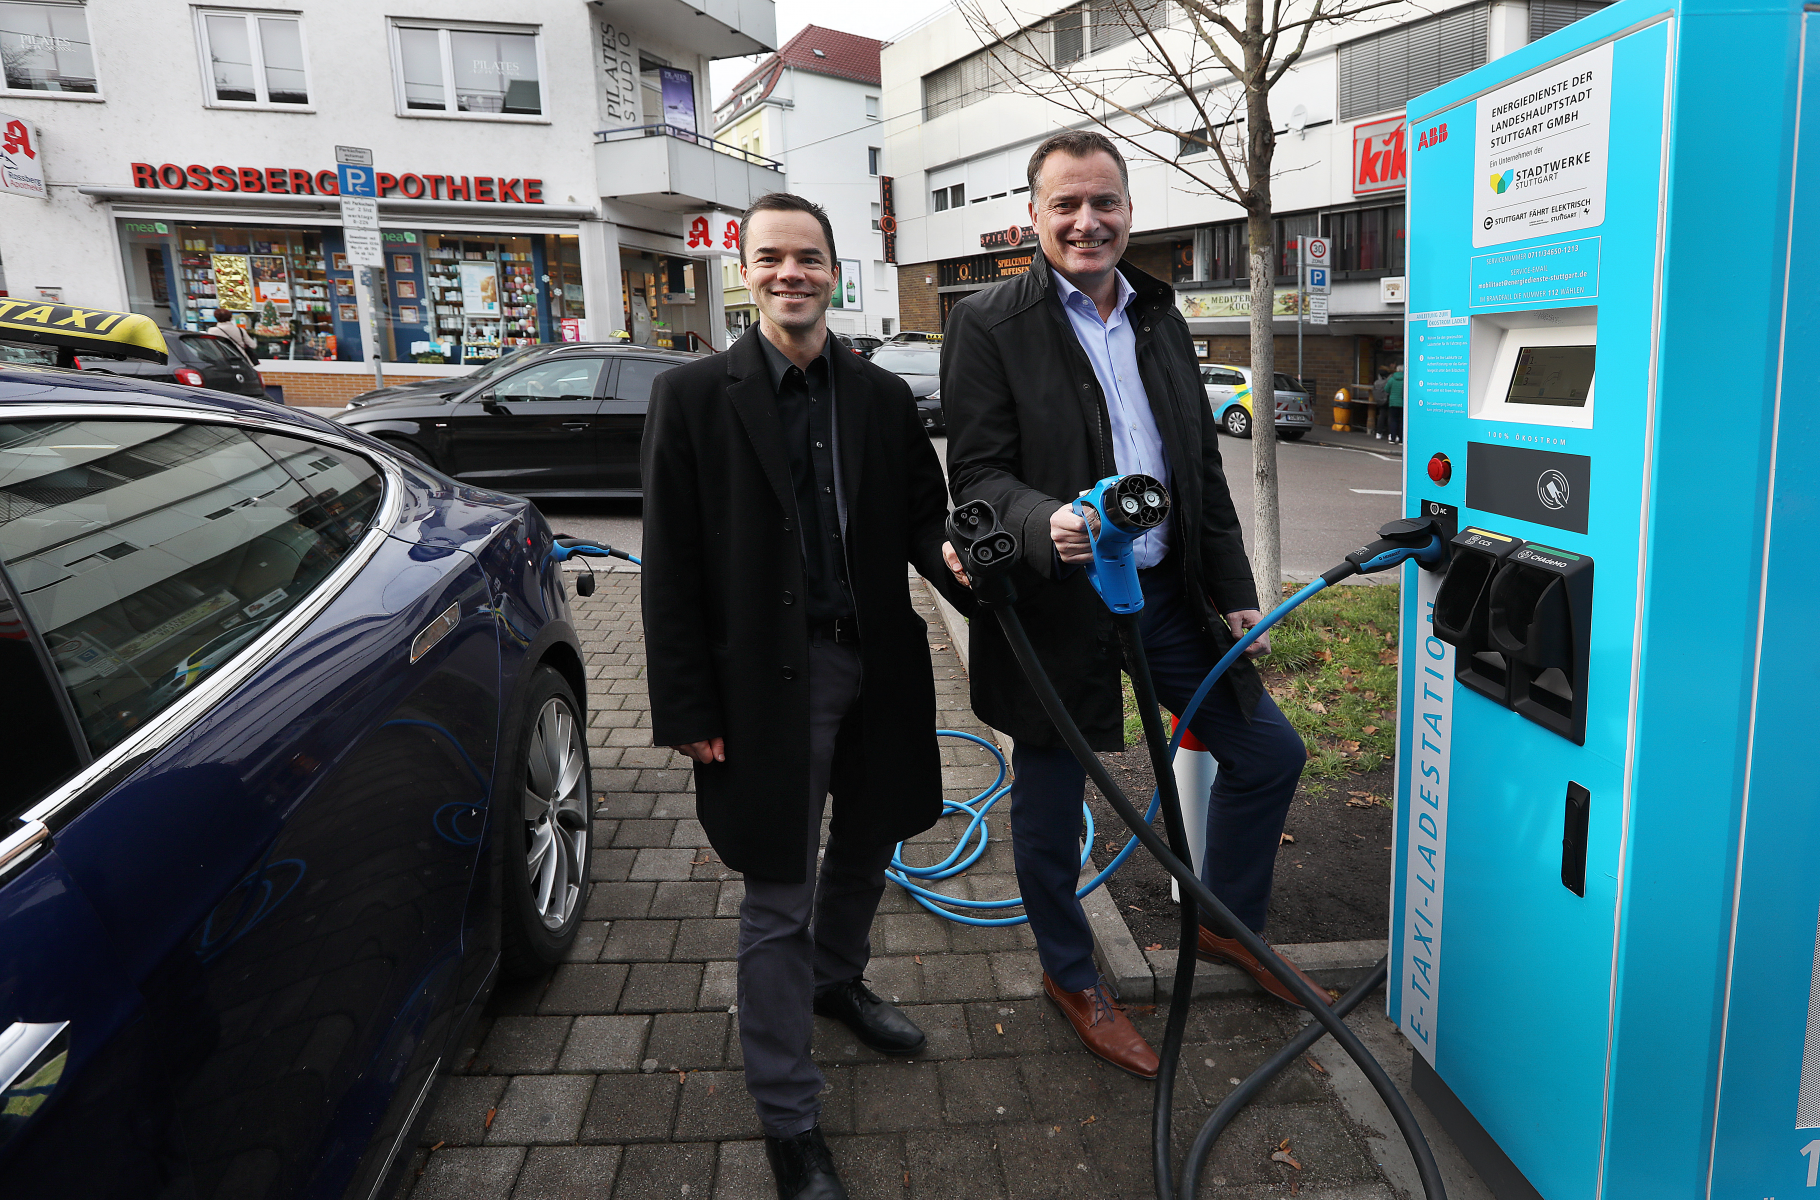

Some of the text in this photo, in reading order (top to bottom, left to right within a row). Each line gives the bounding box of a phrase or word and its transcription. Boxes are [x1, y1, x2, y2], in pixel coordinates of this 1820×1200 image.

[472, 60, 520, 70] PILATES
[601, 22, 622, 120] PILATES
[618, 32, 635, 122] STUDIO
[1491, 70, 1593, 118] ENERGIEDIENSTE DER
[1491, 88, 1593, 133] LANDESHAUPTSTADT
[1417, 122, 1449, 151] ABB
[1490, 110, 1579, 149] STUTTGART GMBH
[1489, 145, 1544, 168] Ein Unternehmen der
[1515, 151, 1591, 182] STADTWERKE
[8, 171, 42, 186] Rossberg
[131, 162, 543, 204] ROSSBERG POTHEKE
[345, 168, 366, 192] P
[1515, 171, 1559, 190] STUTTGART
[1494, 212, 1527, 226] STUTTGART
[1529, 207, 1549, 218] FÄHRT
[1551, 198, 1591, 214] ELEKTRISCH
[1550, 211, 1577, 223] STUTTGART
[125, 223, 155, 233] mea
[980, 232, 1007, 244] SPIEL
[1313, 244, 1323, 254] 30
[1486, 245, 1580, 265] SERVICENUMMER 0711/34650-1213
[997, 255, 1032, 268] SPIELCENTER
[1000, 265, 1030, 276] HUFEISEN
[1313, 271, 1322, 284] P
[1510, 265, 1548, 276] SERVICE-EMAIL
[1478, 270, 1588, 289] mobilitaet@energiedienste-stuttgart.de
[1211, 294, 1252, 304] MEDITER
[1486, 293, 1512, 302] BRANDFALL
[1523, 290, 1547, 298] NUMMER
[1560, 286, 1585, 295] WÄHLEN
[0, 299, 121, 331] TAXI
[1526, 366, 1532, 375] 2
[1522, 377, 1528, 386] 3
[1488, 430, 1567, 446] 100% ÖKOSTROM
[1478, 539, 1492, 547] CCS
[1530, 554, 1568, 568] CHAdeMO
